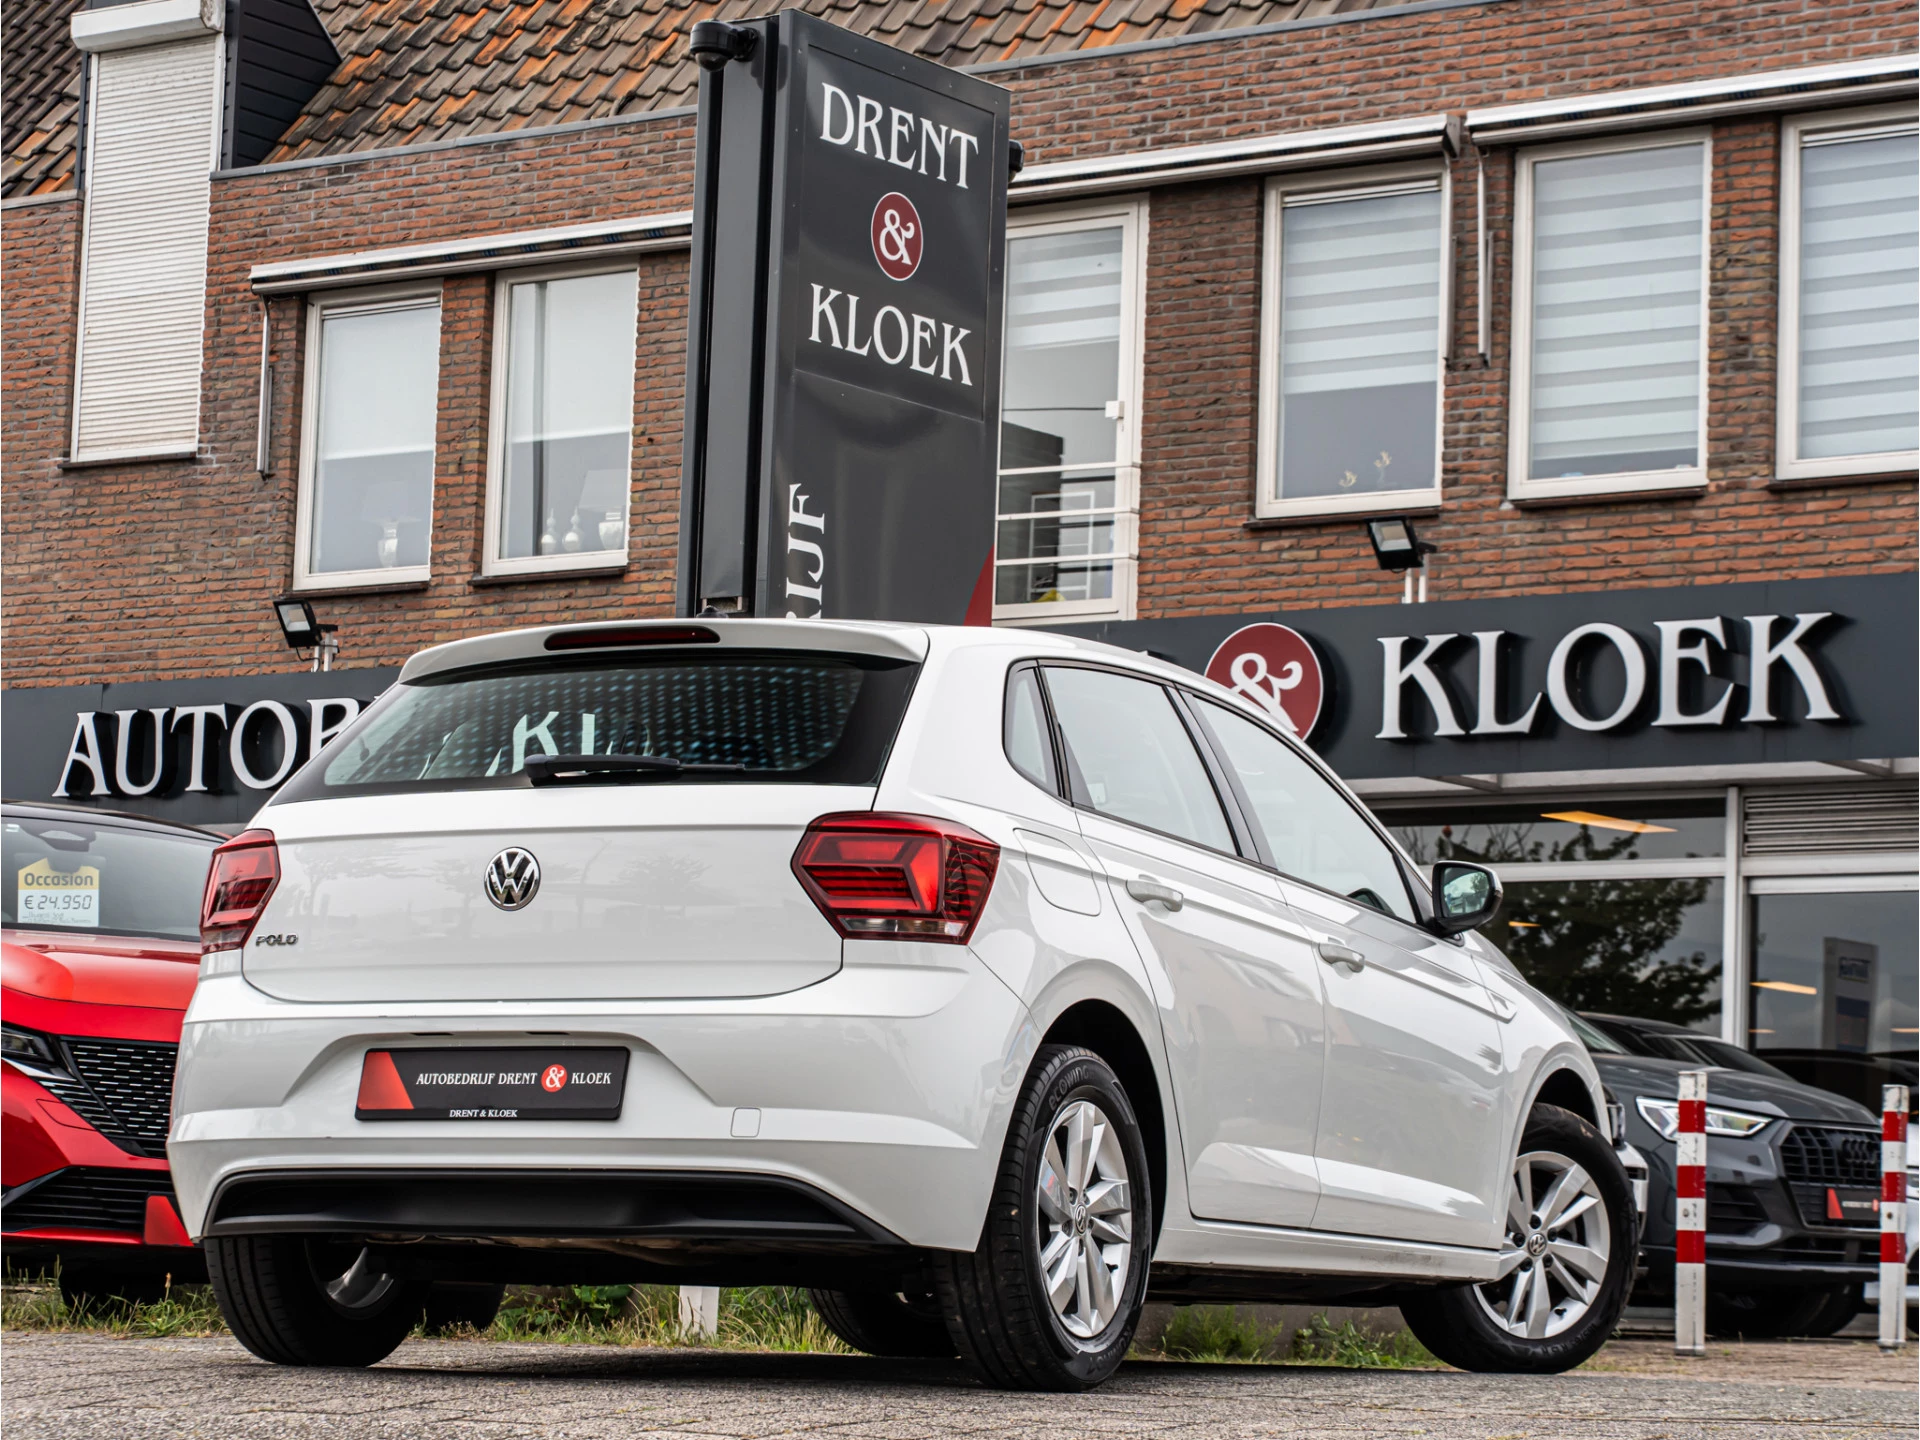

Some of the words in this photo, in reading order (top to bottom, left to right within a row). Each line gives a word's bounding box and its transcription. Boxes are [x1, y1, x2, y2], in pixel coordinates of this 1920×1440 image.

[820, 81, 979, 189] DRENT
[879, 208, 915, 266] &
[808, 282, 973, 387] KLOEK
[786, 483, 825, 619] IJF
[1375, 611, 1841, 740] KLOEK
[52, 697, 364, 798] AUTOB
[24, 872, 94, 887] Occasion
[37, 895, 92, 910] 24.950
[255, 934, 299, 947] POLO
[416, 1073, 495, 1085] AUTOBEDRIJF
[498, 1072, 538, 1085] DRENT
[545, 1067, 565, 1088] &
[571, 1072, 612, 1085] KLOEK
[449, 1109, 479, 1118] DRENT
[479, 1109, 487, 1118] &
[487, 1109, 518, 1118] KLOEK
